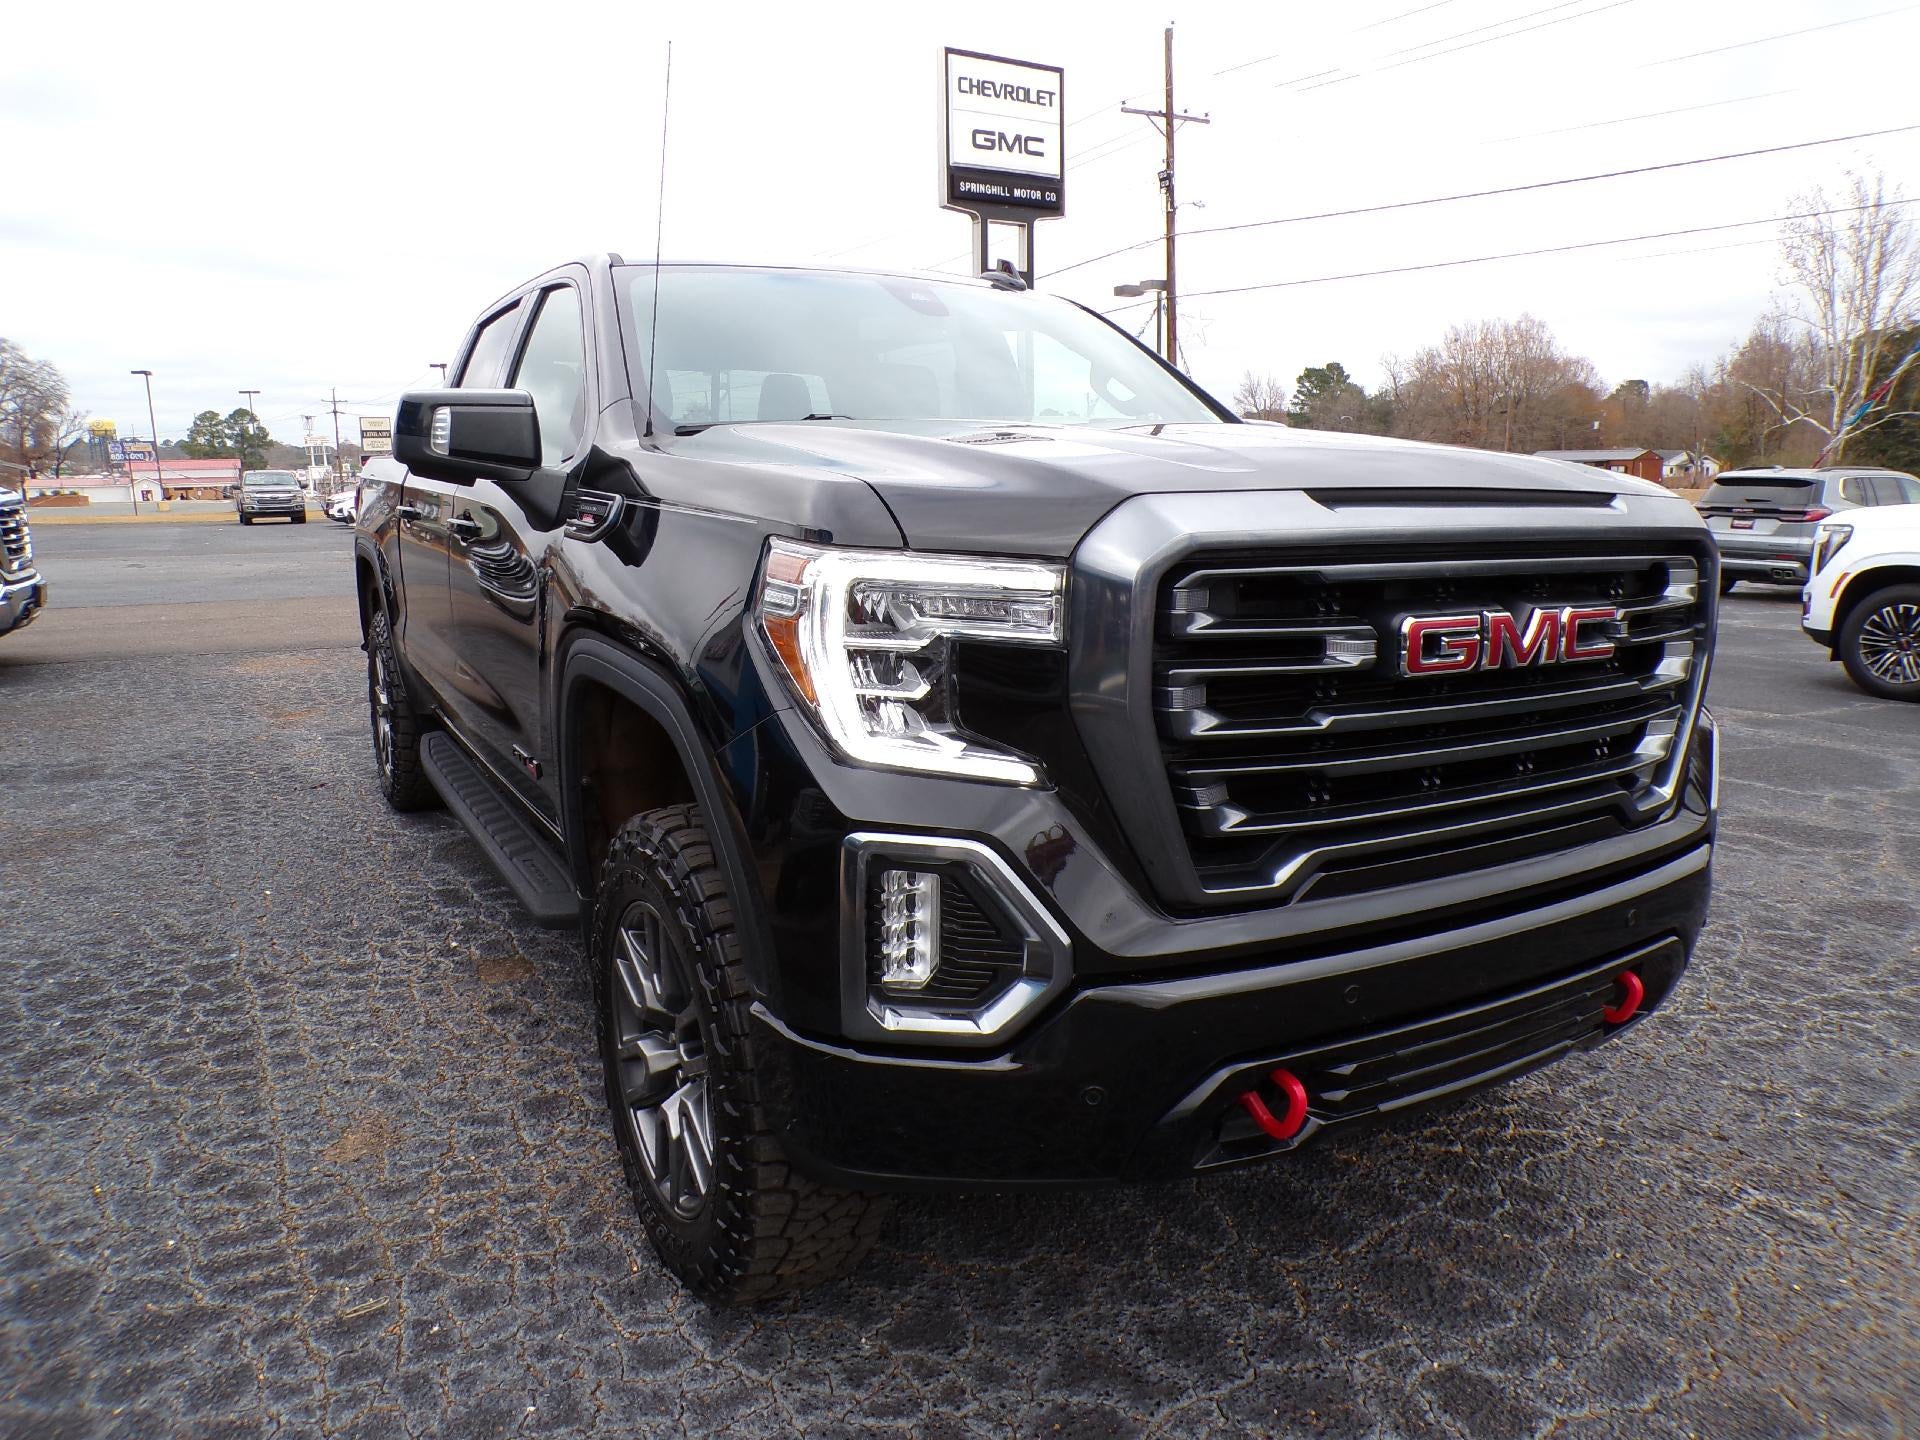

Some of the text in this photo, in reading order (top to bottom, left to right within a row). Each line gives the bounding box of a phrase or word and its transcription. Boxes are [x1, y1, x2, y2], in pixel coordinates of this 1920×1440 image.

[957, 76, 1055, 107] CHEVROLET
[971, 128, 1045, 158] GMC
[959, 181, 1010, 197] SPRINGHILL
[1013, 187, 1042, 200] MOTOR
[1399, 607, 1617, 678] GMC
